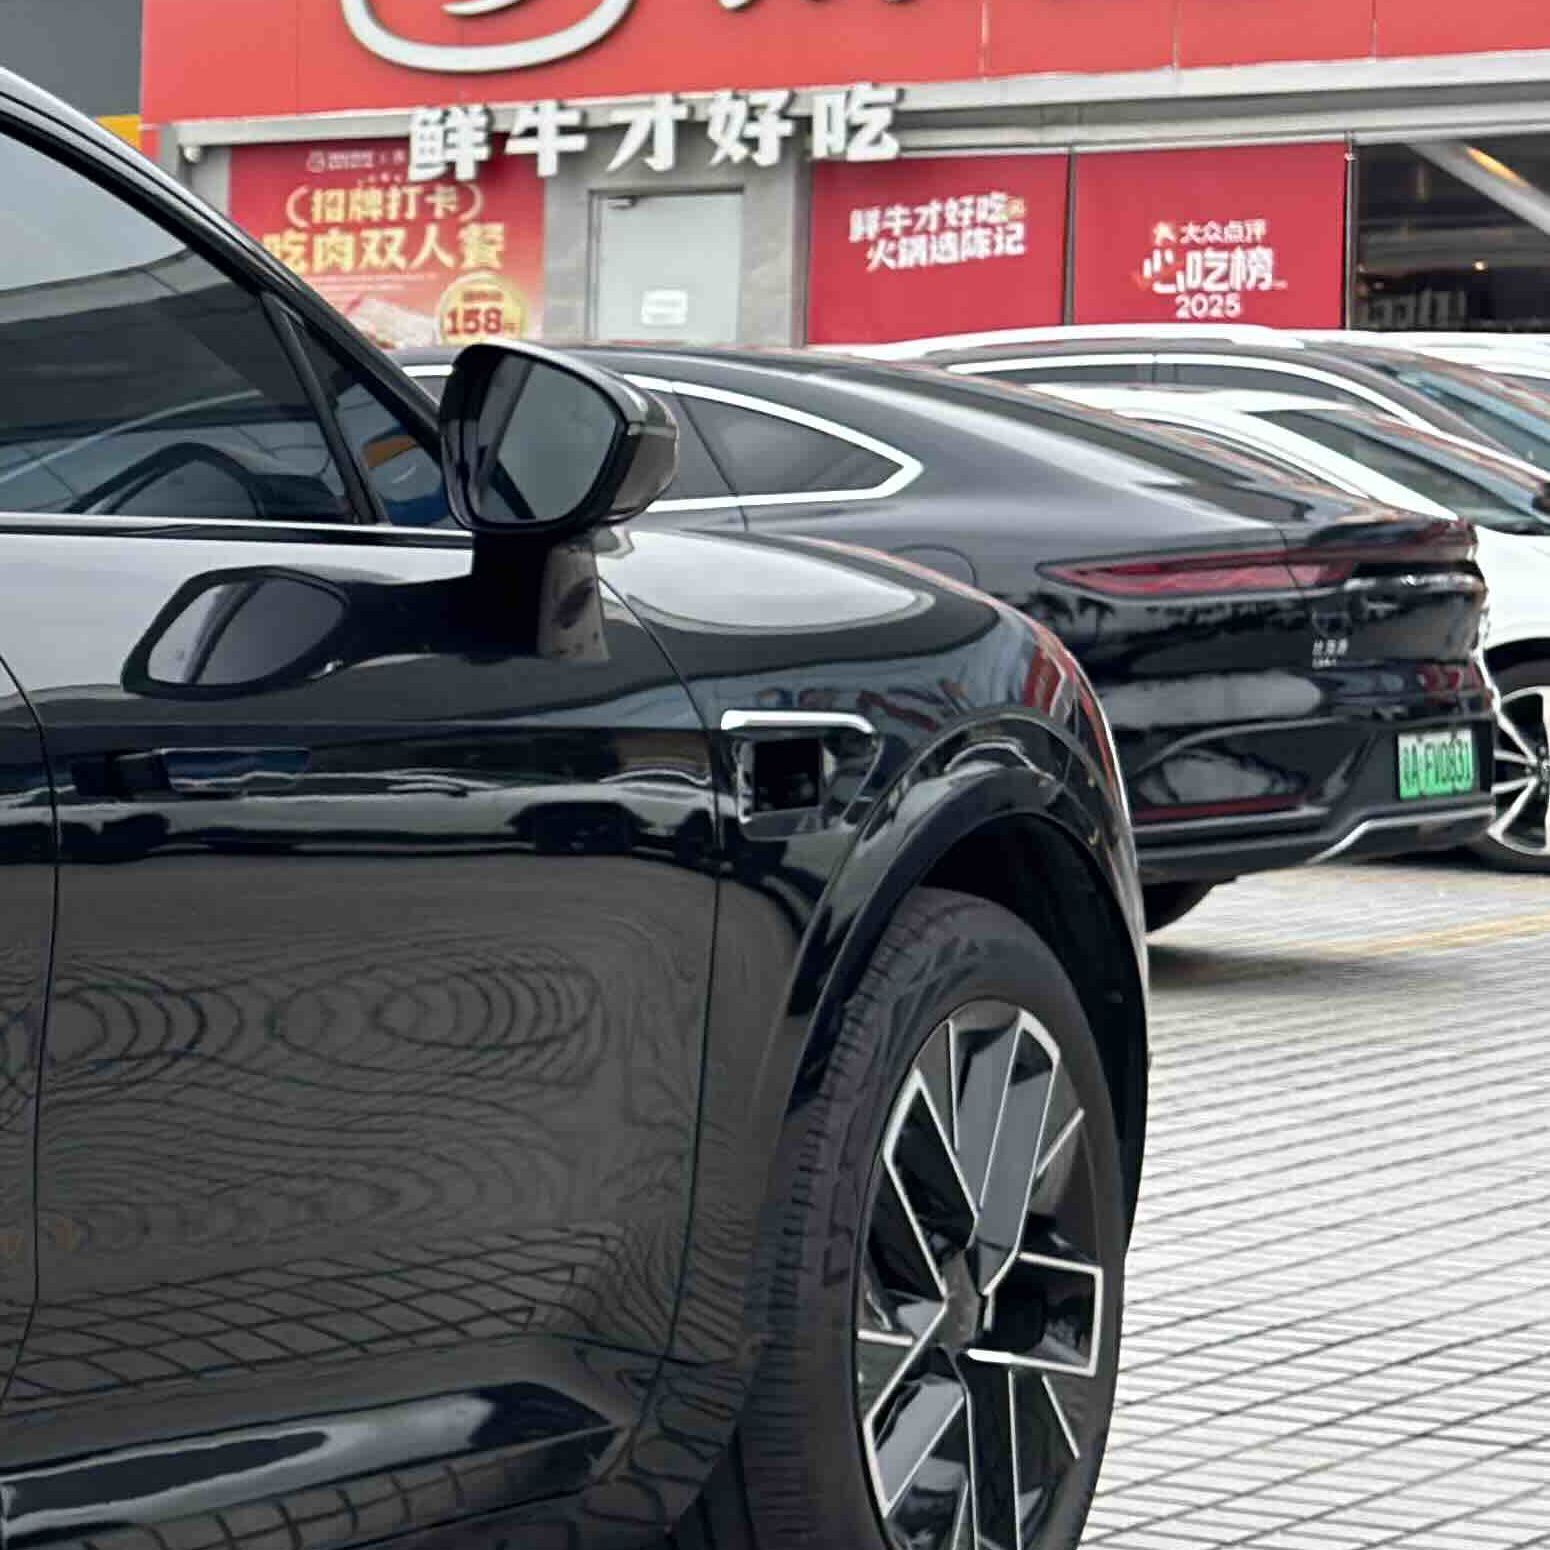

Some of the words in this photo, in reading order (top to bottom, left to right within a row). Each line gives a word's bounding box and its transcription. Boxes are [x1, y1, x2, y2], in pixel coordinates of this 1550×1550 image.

[1179, 219, 1268, 245] 大众点评
[1175, 293, 1242, 319] 2025
[446, 308, 503, 337] 158
